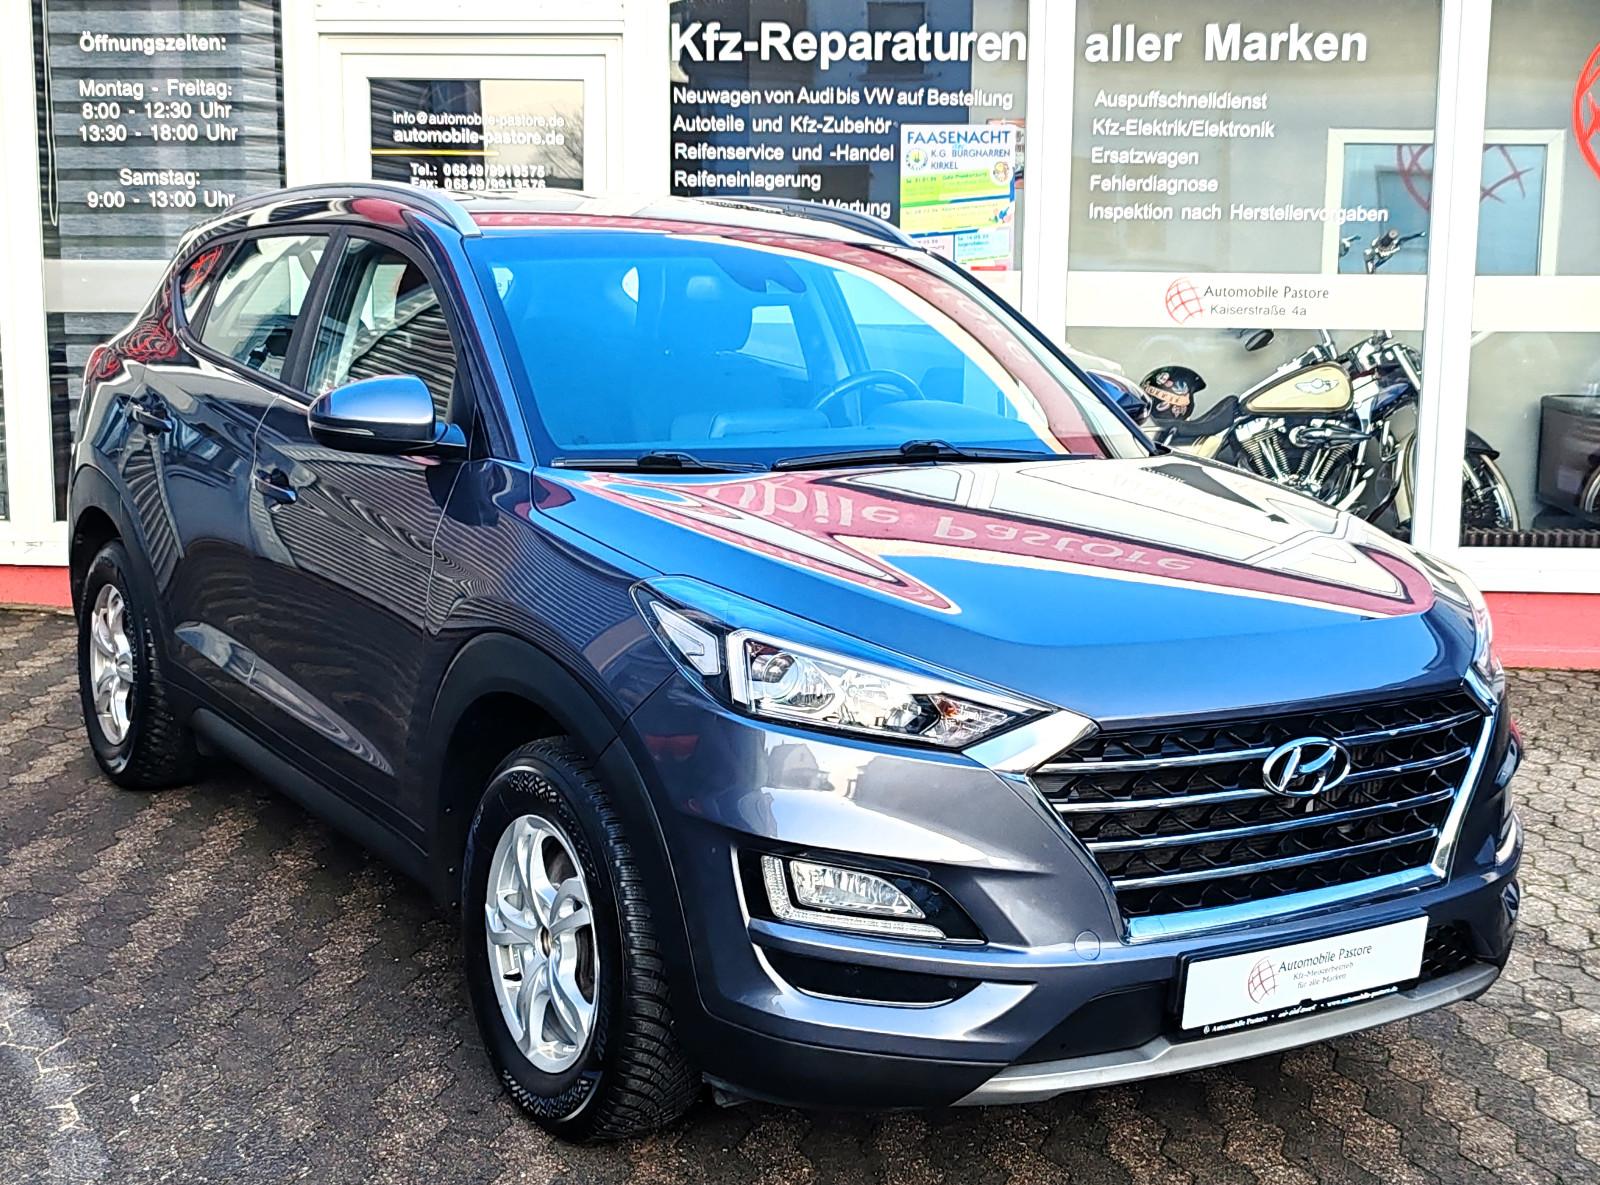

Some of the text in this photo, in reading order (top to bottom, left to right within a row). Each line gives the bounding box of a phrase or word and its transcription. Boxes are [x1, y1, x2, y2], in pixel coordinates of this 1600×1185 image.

[79, 31, 227, 55] Öffnungszeiten:
[670, 21, 1026, 70] Kfz-Reparaturen
[1084, 22, 1367, 62] aller Marken
[79, 80, 144, 100] Montag
[166, 79, 232, 100] Freitag:
[673, 87, 1013, 110] Neuwagen von Audi bis VW auf Bestellung
[82, 102, 121, 119] 8:00
[144, 102, 192, 119] 12:30
[200, 102, 232, 118] Uhr
[1094, 90, 1268, 111] Auspuffschnelldienst
[80, 125, 127, 142] 13:30
[151, 124, 198, 141] 18:00
[206, 124, 239, 141] Uhr
[673, 115, 892, 134] Autoteile und Kfz-Zubehör
[1092, 118, 1275, 138] Kfz-Elektrik/Elektronik
[906, 130, 1011, 145] FAASENACHT
[674, 143, 894, 161] Reifenservice und -Handel
[1091, 146, 1199, 168] Ersatzwagen
[119, 168, 201, 189] Samstag:
[410, 162, 438, 177] Tel.:
[674, 170, 822, 191] Reifeneinlagerung
[1090, 175, 1218, 195] Fehlerdiagnose
[87, 191, 126, 208] 9:00
[149, 191, 196, 208] 13:00
[204, 191, 236, 208] Uhr
[1089, 203, 1173, 223] Inspektion
[1181, 204, 1222, 220] nach
[1203, 285, 1329, 299] Automobile Pastore
[1210, 304, 1307, 316] Kaiserstraße 4a
[1278, 944, 1373, 972] Automobile Pastore
